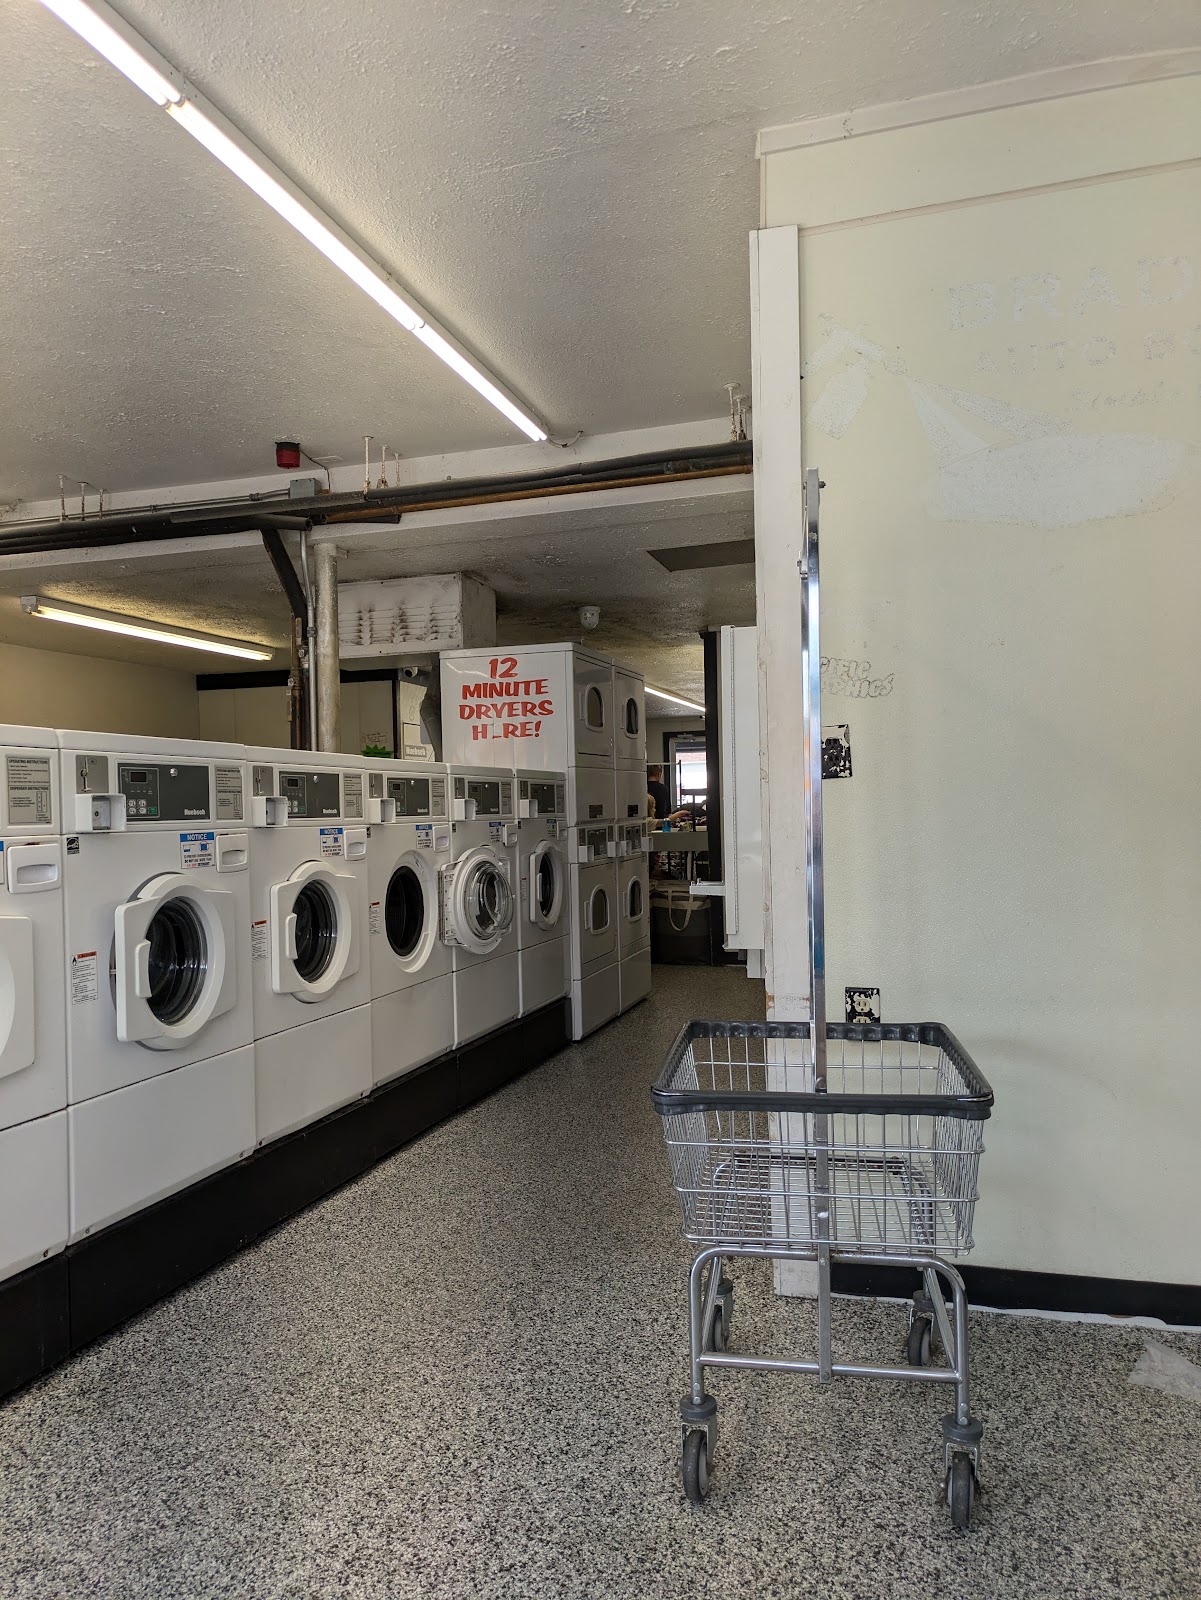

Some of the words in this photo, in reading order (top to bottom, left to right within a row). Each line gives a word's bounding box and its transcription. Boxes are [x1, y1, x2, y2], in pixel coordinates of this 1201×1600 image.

[488, 657, 519, 680] 12
[462, 678, 549, 700] MINUTE
[458, 699, 554, 720] DRYERS
[472, 720, 542, 741] HRE!
[186, 833, 208, 841] NOTICE
